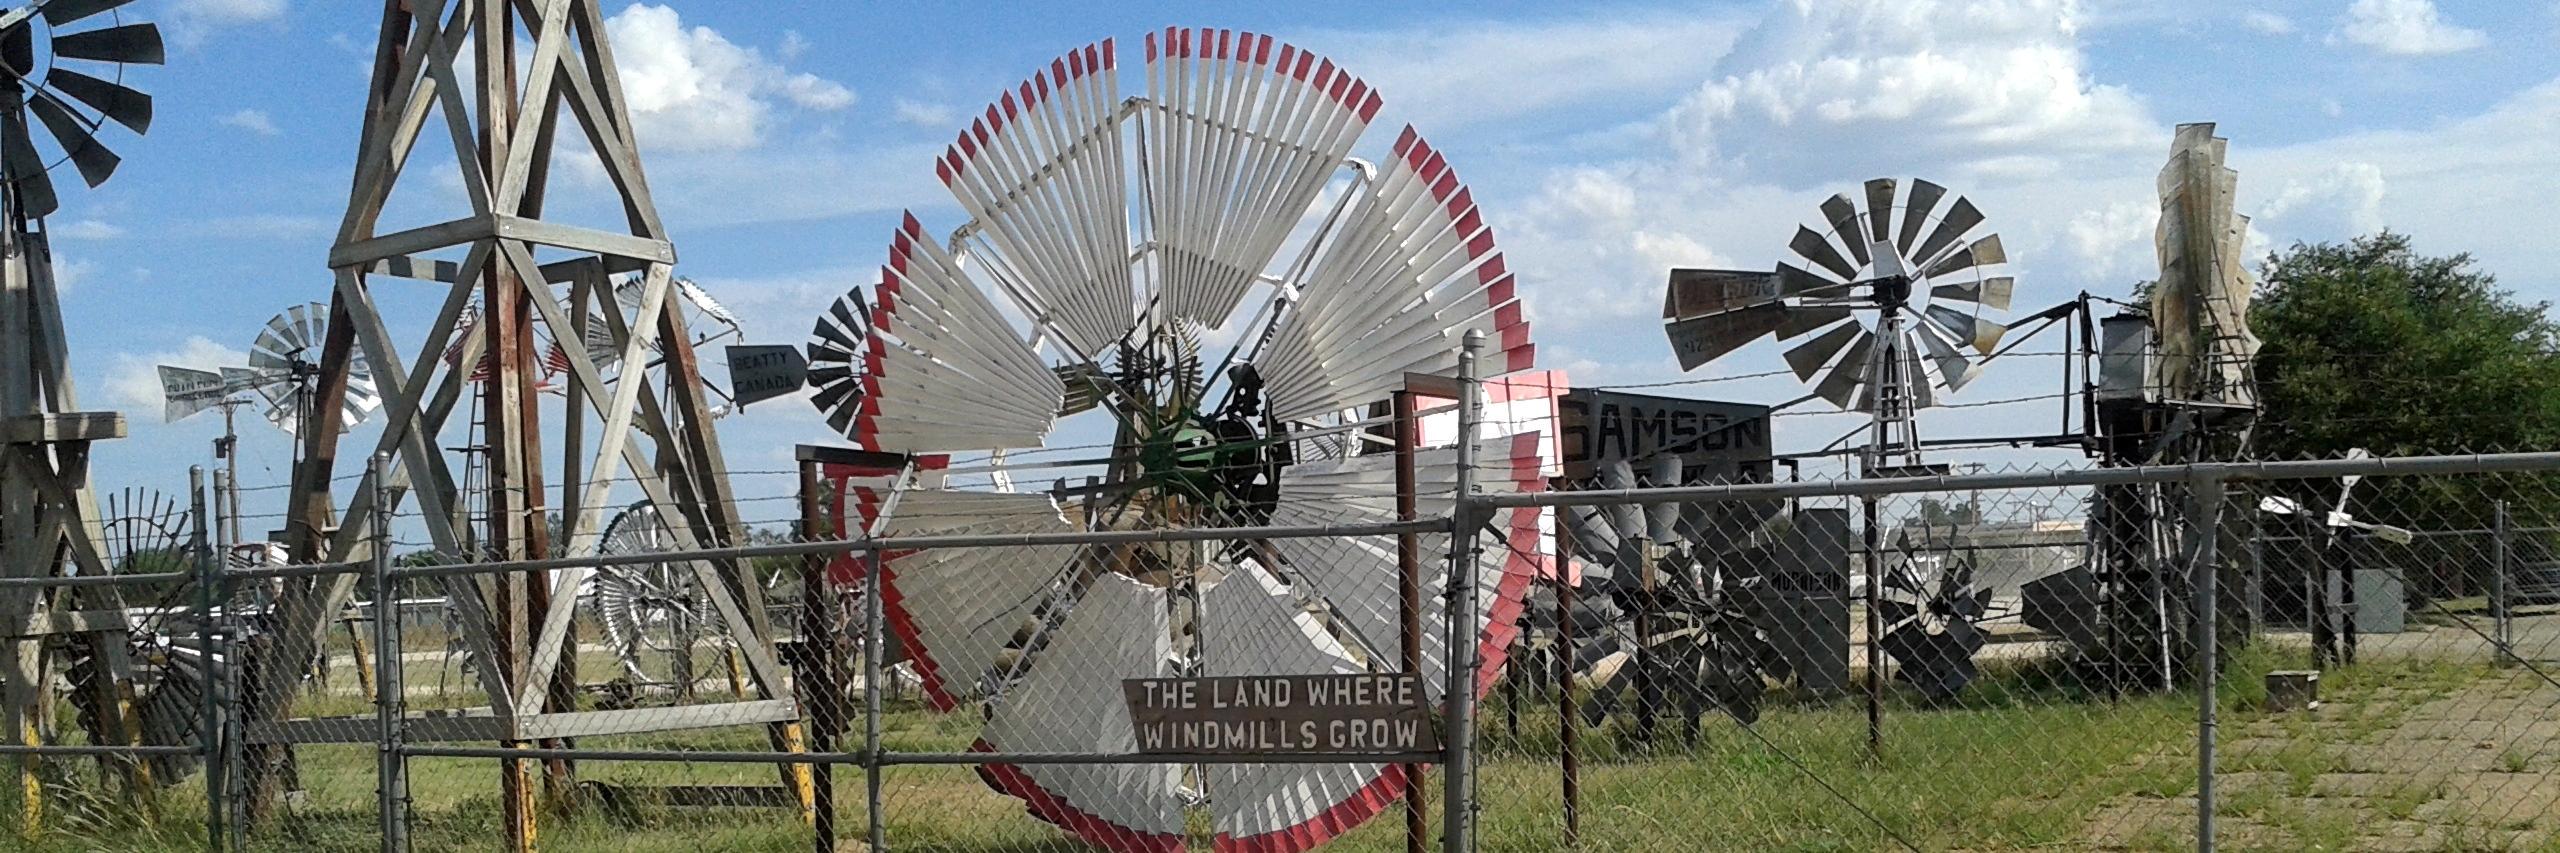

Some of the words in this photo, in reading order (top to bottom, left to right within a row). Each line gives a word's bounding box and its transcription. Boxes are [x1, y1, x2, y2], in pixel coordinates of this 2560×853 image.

[733, 351, 788, 371] BEATTY
[734, 375, 796, 394] CANADA
[1558, 400, 1762, 461] SAMSON
[1142, 681, 1197, 709] THE
[1213, 678, 1291, 709] LAND
[1308, 676, 1415, 707] WHERE
[1143, 719, 1317, 749] WINDMILLS
[1329, 718, 1418, 749] GROW
